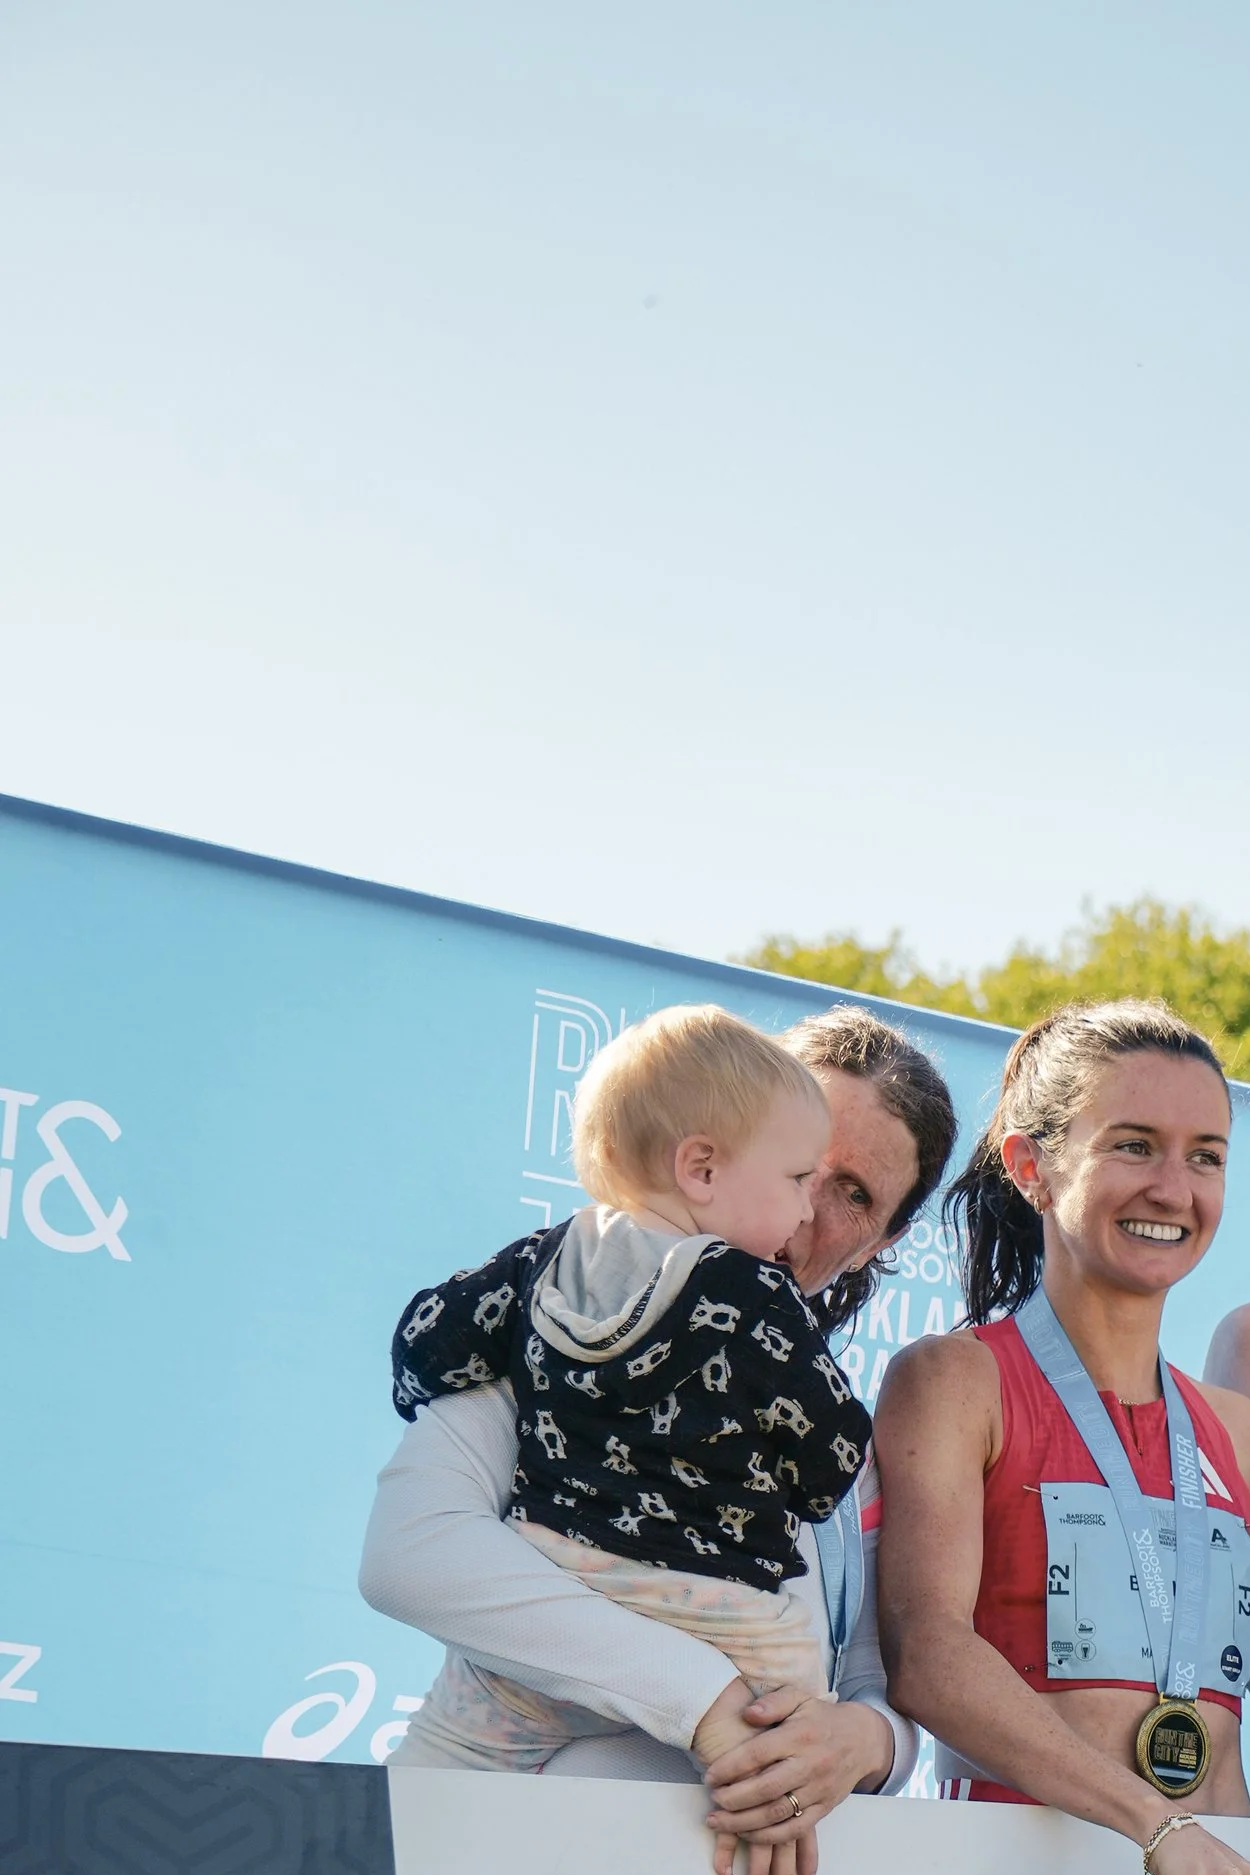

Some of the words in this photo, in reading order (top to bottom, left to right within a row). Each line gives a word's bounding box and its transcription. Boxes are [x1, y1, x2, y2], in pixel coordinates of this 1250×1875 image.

[1176, 1433, 1201, 1509] FINISHER
[1049, 1565, 1070, 1595] F2
[1149, 1545, 1172, 1624] THOMPSON
